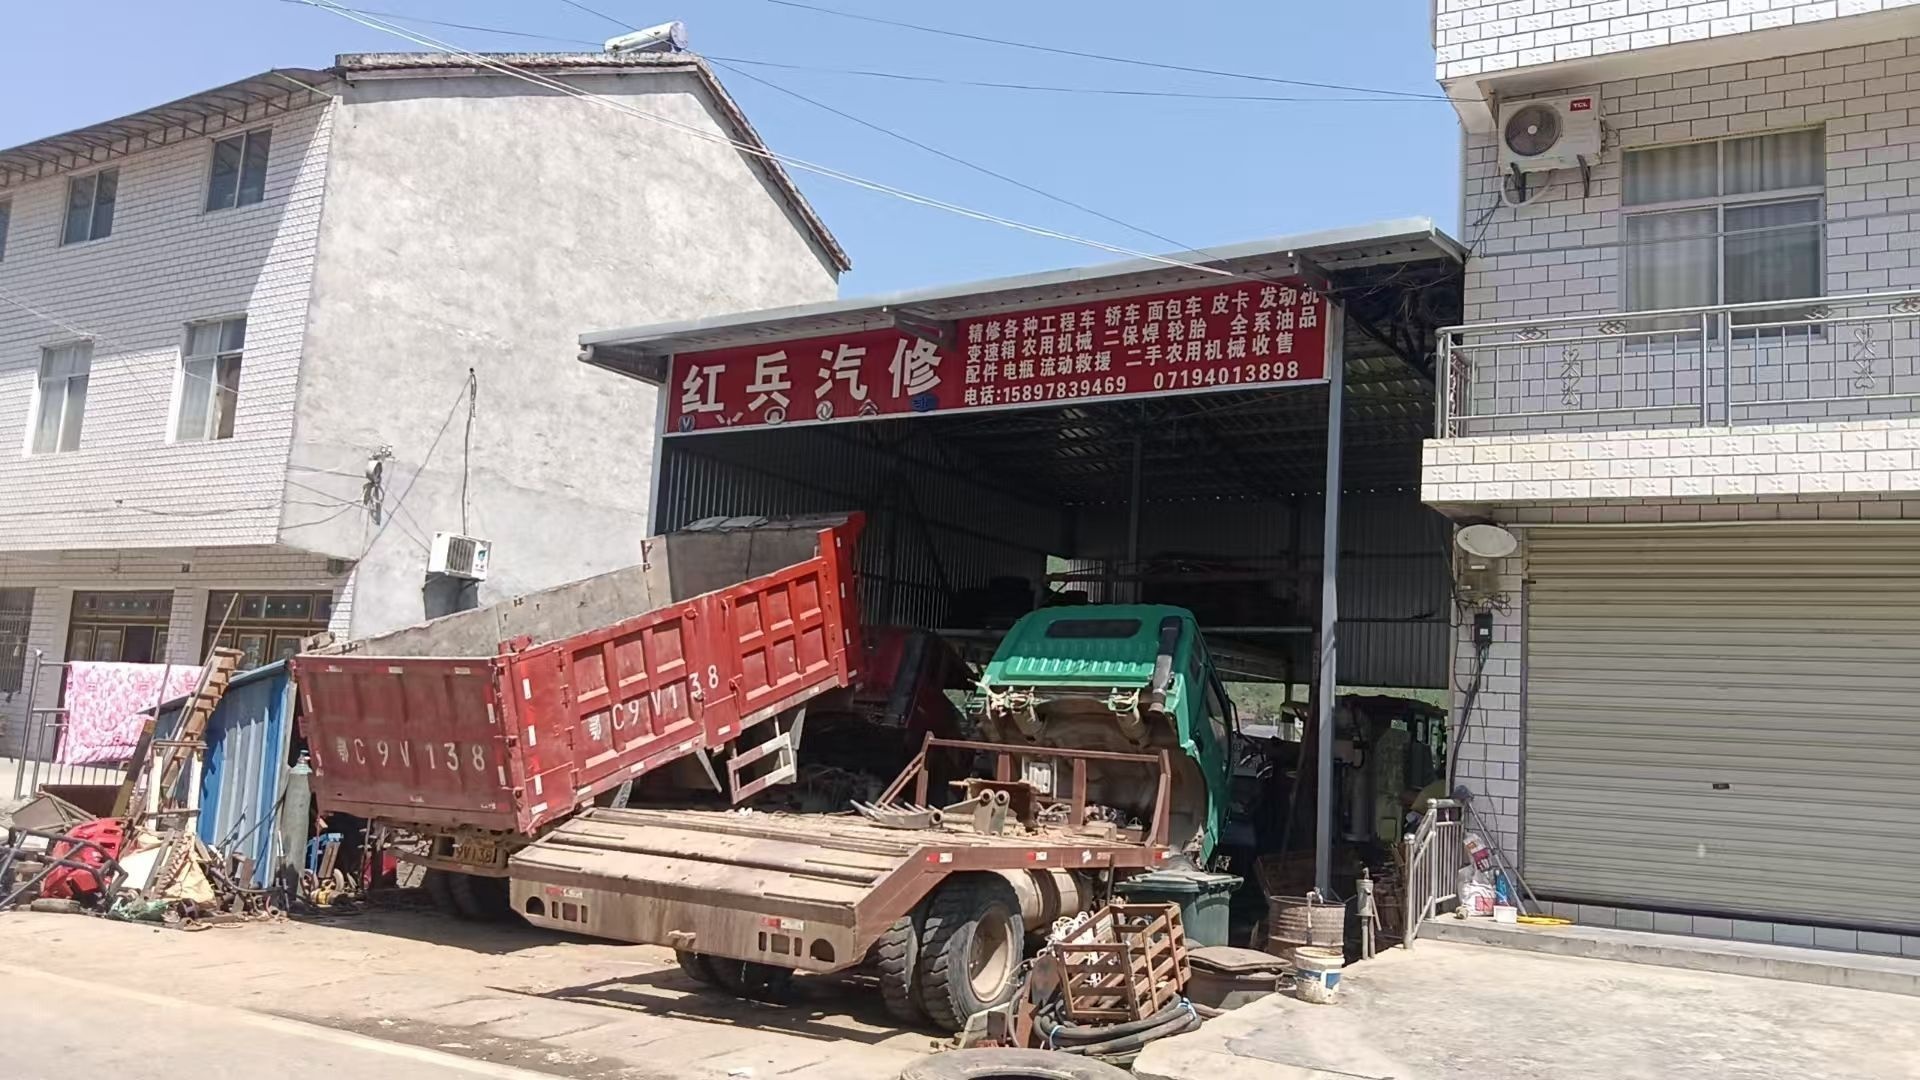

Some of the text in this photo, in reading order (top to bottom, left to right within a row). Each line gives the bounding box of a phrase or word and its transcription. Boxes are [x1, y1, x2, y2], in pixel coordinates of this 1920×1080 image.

[967, 306, 1316, 364] 变速箱 农用机械 二保焊 轮胎 全系油品
[968, 309, 1095, 343] 精修各种工程车
[1105, 304, 1140, 326] 轿车
[1147, 296, 1201, 322] 面包车
[1211, 290, 1250, 314] 皮卡
[681, 338, 943, 414] 红兵汽修
[964, 361, 1298, 405] 电话:15897839469 07194013898
[965, 331, 1293, 384] 配件 电瓶 流动救援 二手农用机械收售
